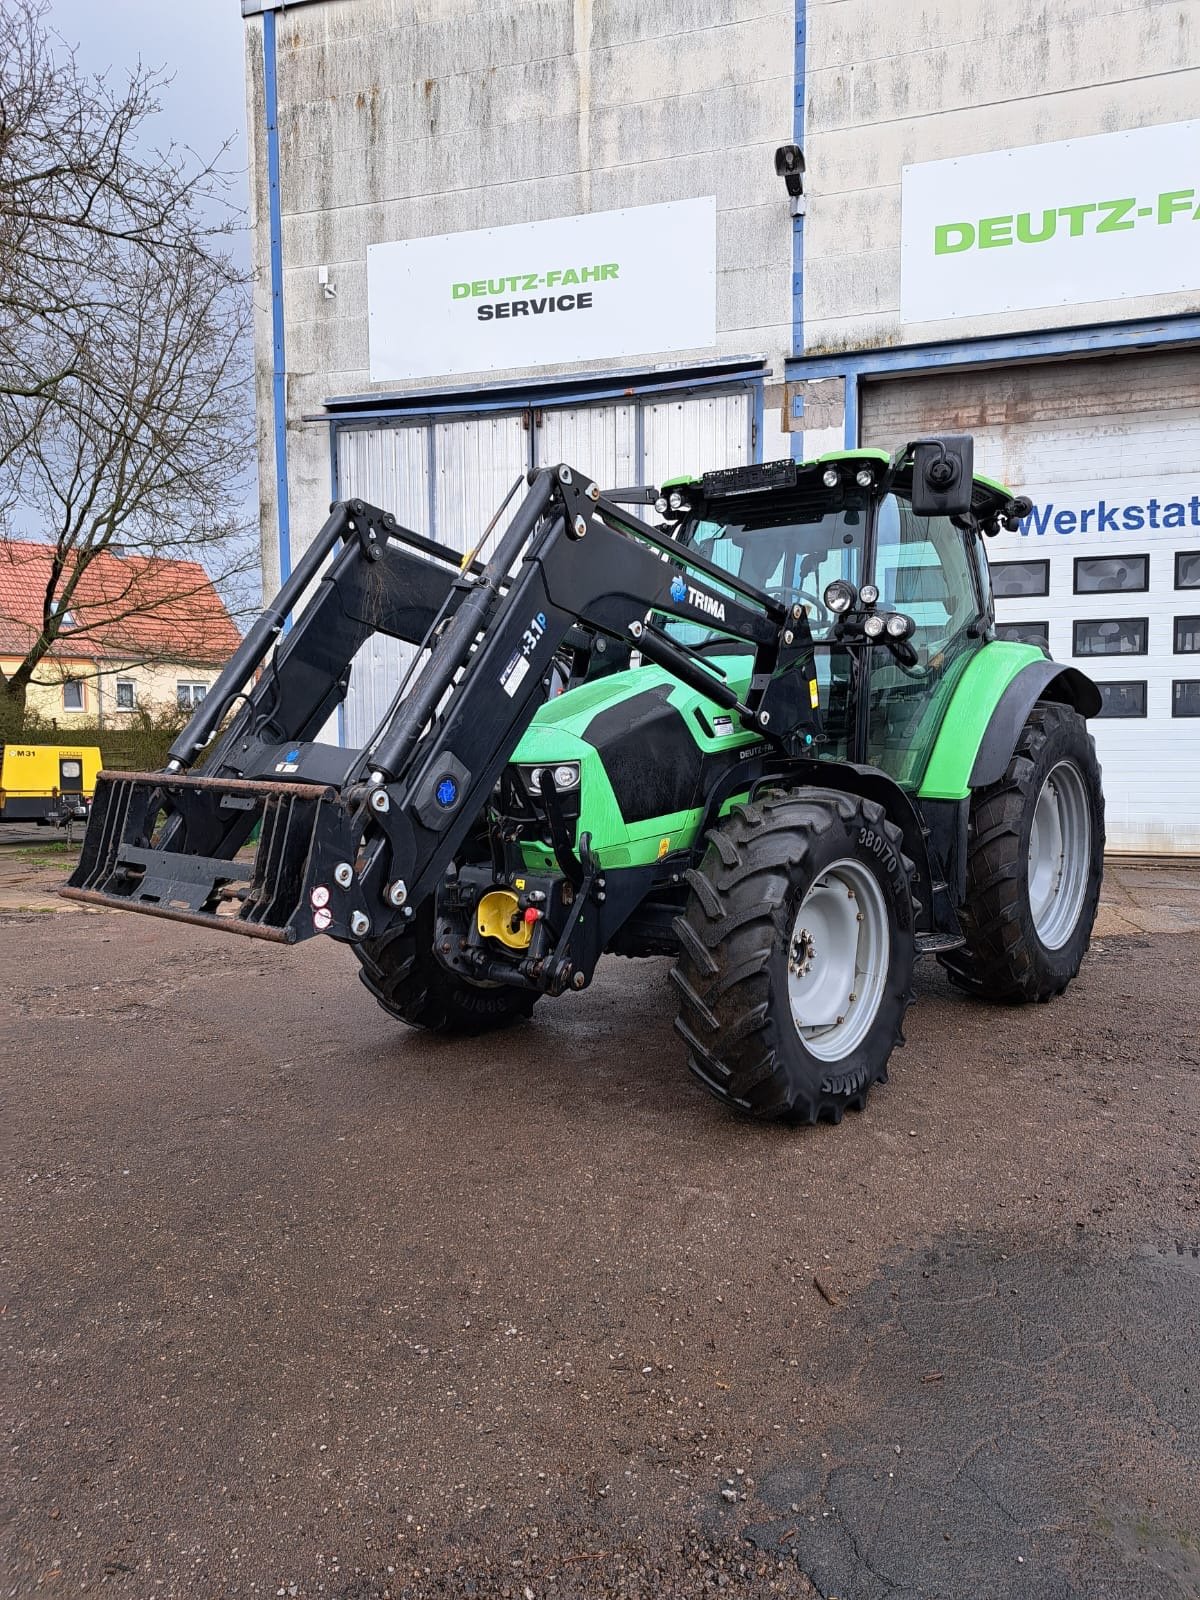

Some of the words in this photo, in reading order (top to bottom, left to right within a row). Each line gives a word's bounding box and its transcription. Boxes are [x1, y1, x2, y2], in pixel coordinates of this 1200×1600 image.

[934, 188, 1200, 256] DEUTZ-F
[452, 263, 620, 300] DEUTZ-FAHR
[477, 292, 593, 322] SERVICE
[687, 585, 726, 623] TRIMA
[858, 827, 897, 873] 380/70
